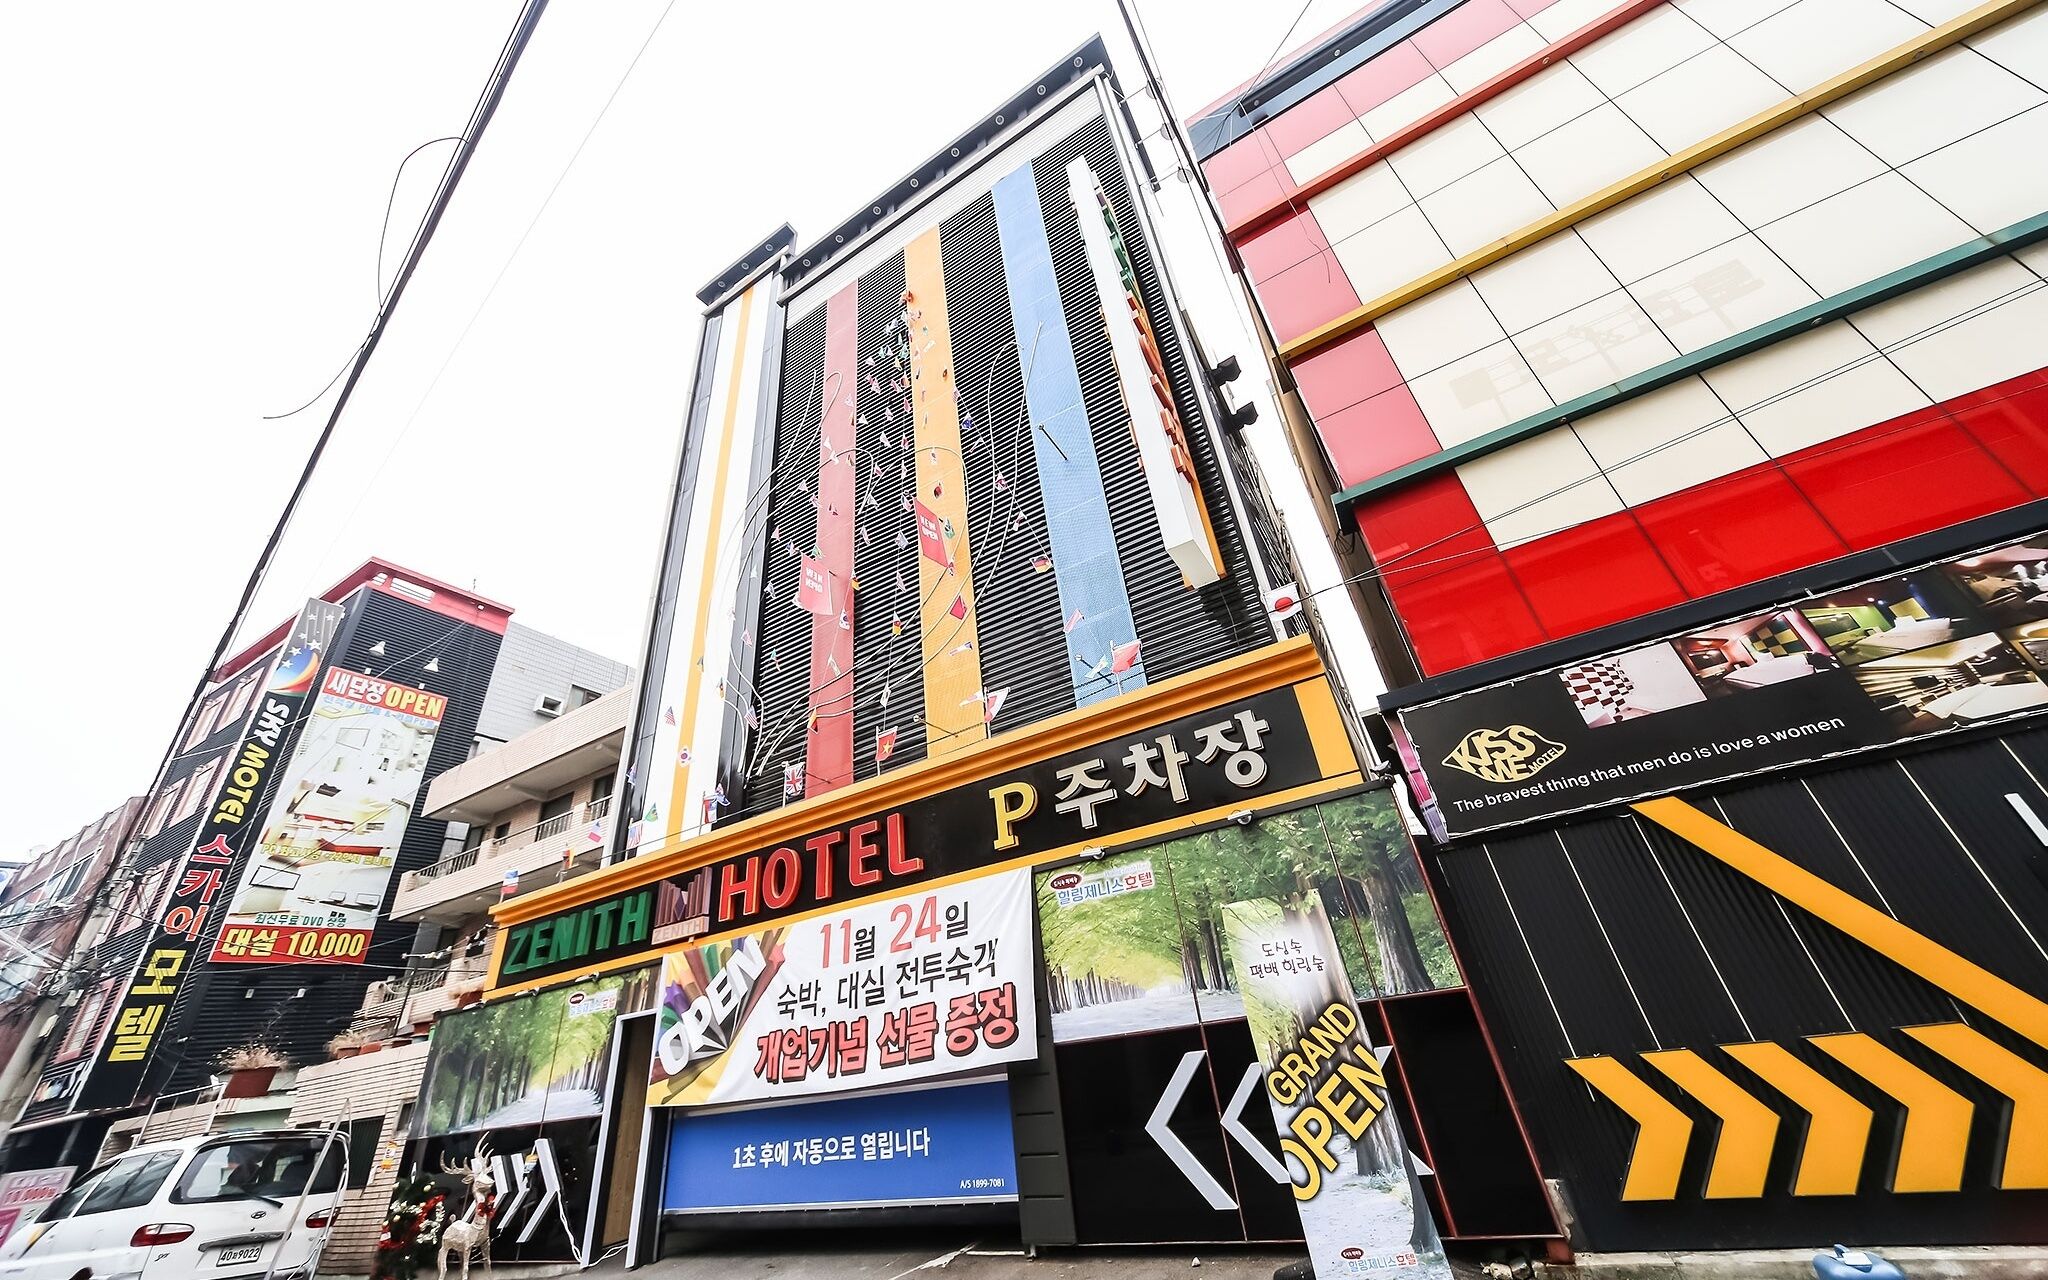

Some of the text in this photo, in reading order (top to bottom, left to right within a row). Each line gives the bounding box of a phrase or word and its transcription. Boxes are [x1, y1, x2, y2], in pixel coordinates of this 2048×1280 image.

[328, 671, 387, 704] 새단장
[384, 686, 443, 718] OPEN
[213, 698, 290, 824] SKY MOTEL
[988, 710, 1270, 849] P 주차장
[1452, 725, 1536, 773] KISS
[1453, 717, 1845, 813] The bravest thing that men do is love a women
[1479, 757, 1531, 781] ME
[163, 834, 234, 942] 스카이
[302, 916, 324, 926] DVD
[503, 812, 924, 975] ZENITH HOTEL
[654, 917, 705, 943] ZENITH
[820, 896, 968, 968] 11월 24일
[221, 928, 366, 958] 대실 10,000
[778, 938, 999, 1020] 숙박, 대실 전투숙객
[107, 949, 187, 1062] 모텔
[658, 934, 767, 1076] OPEN
[754, 982, 1019, 1084] 개업기념 선물 증정
[1267, 1002, 1357, 1105] GRAND
[732, 1127, 930, 1168] 1초 후에 자동으로 열립니다
[1279, 1043, 1387, 1201] OPEN
[960, 1179, 971, 1189] A/S
